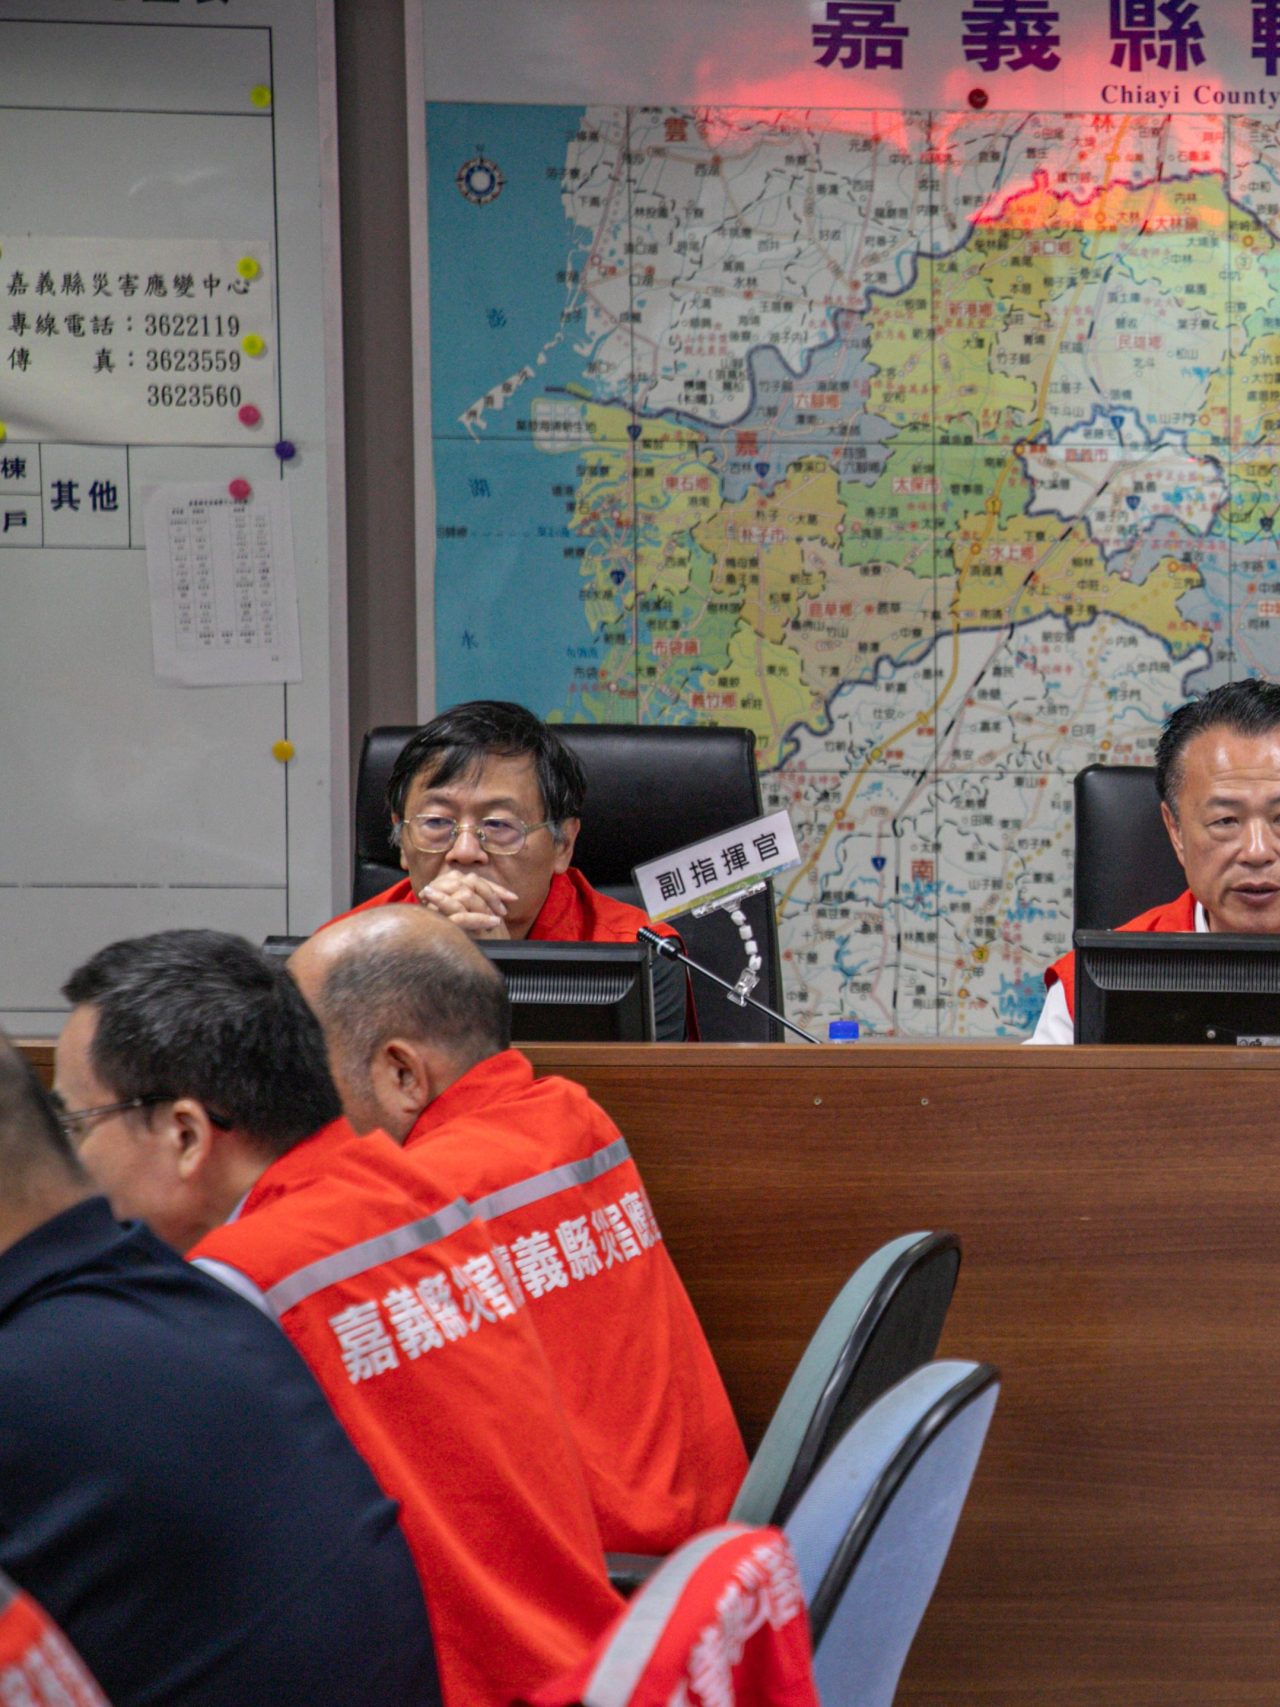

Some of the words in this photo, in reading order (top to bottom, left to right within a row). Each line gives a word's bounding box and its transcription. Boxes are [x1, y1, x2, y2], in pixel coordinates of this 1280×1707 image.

[1101, 84, 1181, 106] Chiayi
[1194, 84, 1280, 110] County
[7, 271, 252, 299] 嘉義縣災害應變中心
[147, 385, 242, 408] 3623560
[50, 480, 119, 512] 其他
[655, 832, 780, 901] 副指揮官
